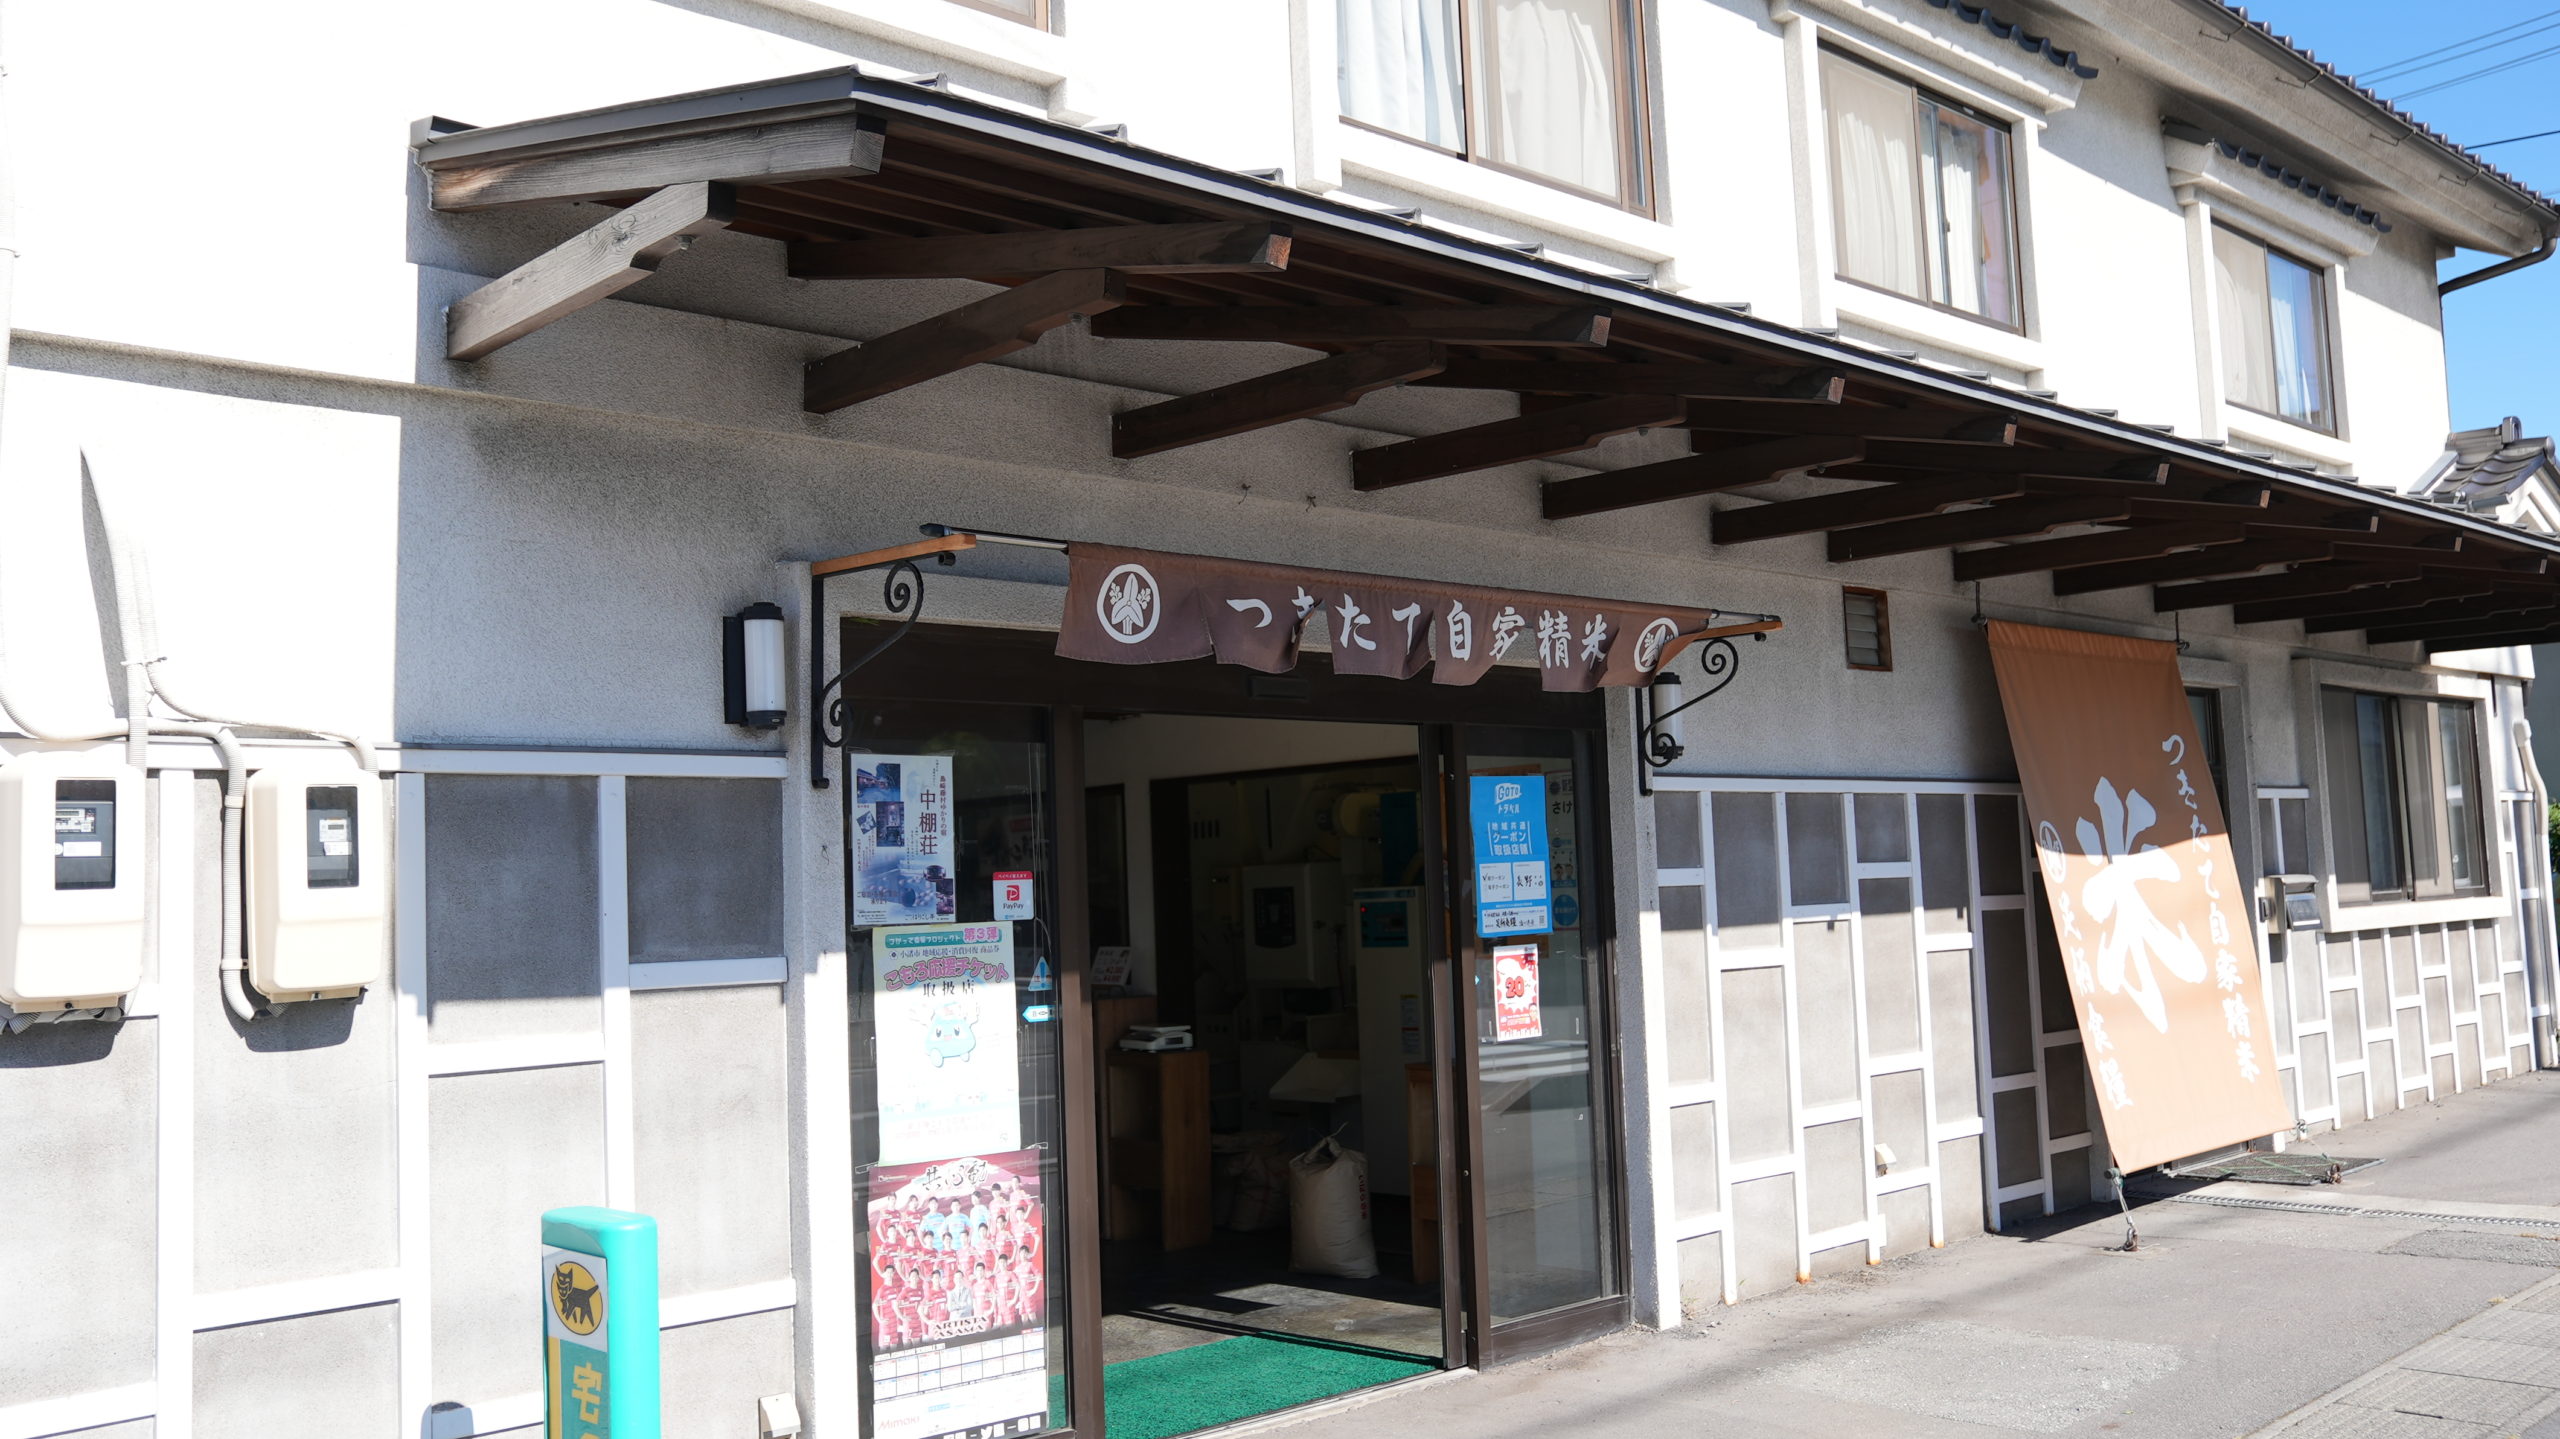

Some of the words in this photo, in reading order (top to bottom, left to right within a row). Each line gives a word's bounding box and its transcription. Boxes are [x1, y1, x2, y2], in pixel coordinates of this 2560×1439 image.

[1498, 803, 1521, 814] トラベル
[919, 789, 938, 856] 中棚荘
[1492, 821, 1527, 831] 地域共通
[1492, 831, 1527, 843] クーポン
[1493, 842, 1528, 856] 取扱店舗
[1003, 902, 1024, 911] PayPay
[2074, 775, 2209, 1035] 米
[2160, 733, 2261, 1084] つきたて自家精米
[964, 926, 999, 942] 第3弾
[885, 957, 1010, 991] こもろ応援チケット
[923, 979, 975, 998] 取扱店
[1505, 975, 1526, 999] 20
[934, 1316, 989, 1331] ARTISTA
[935, 1324, 986, 1339] ASAMA
[571, 1362, 604, 1439] 宅
